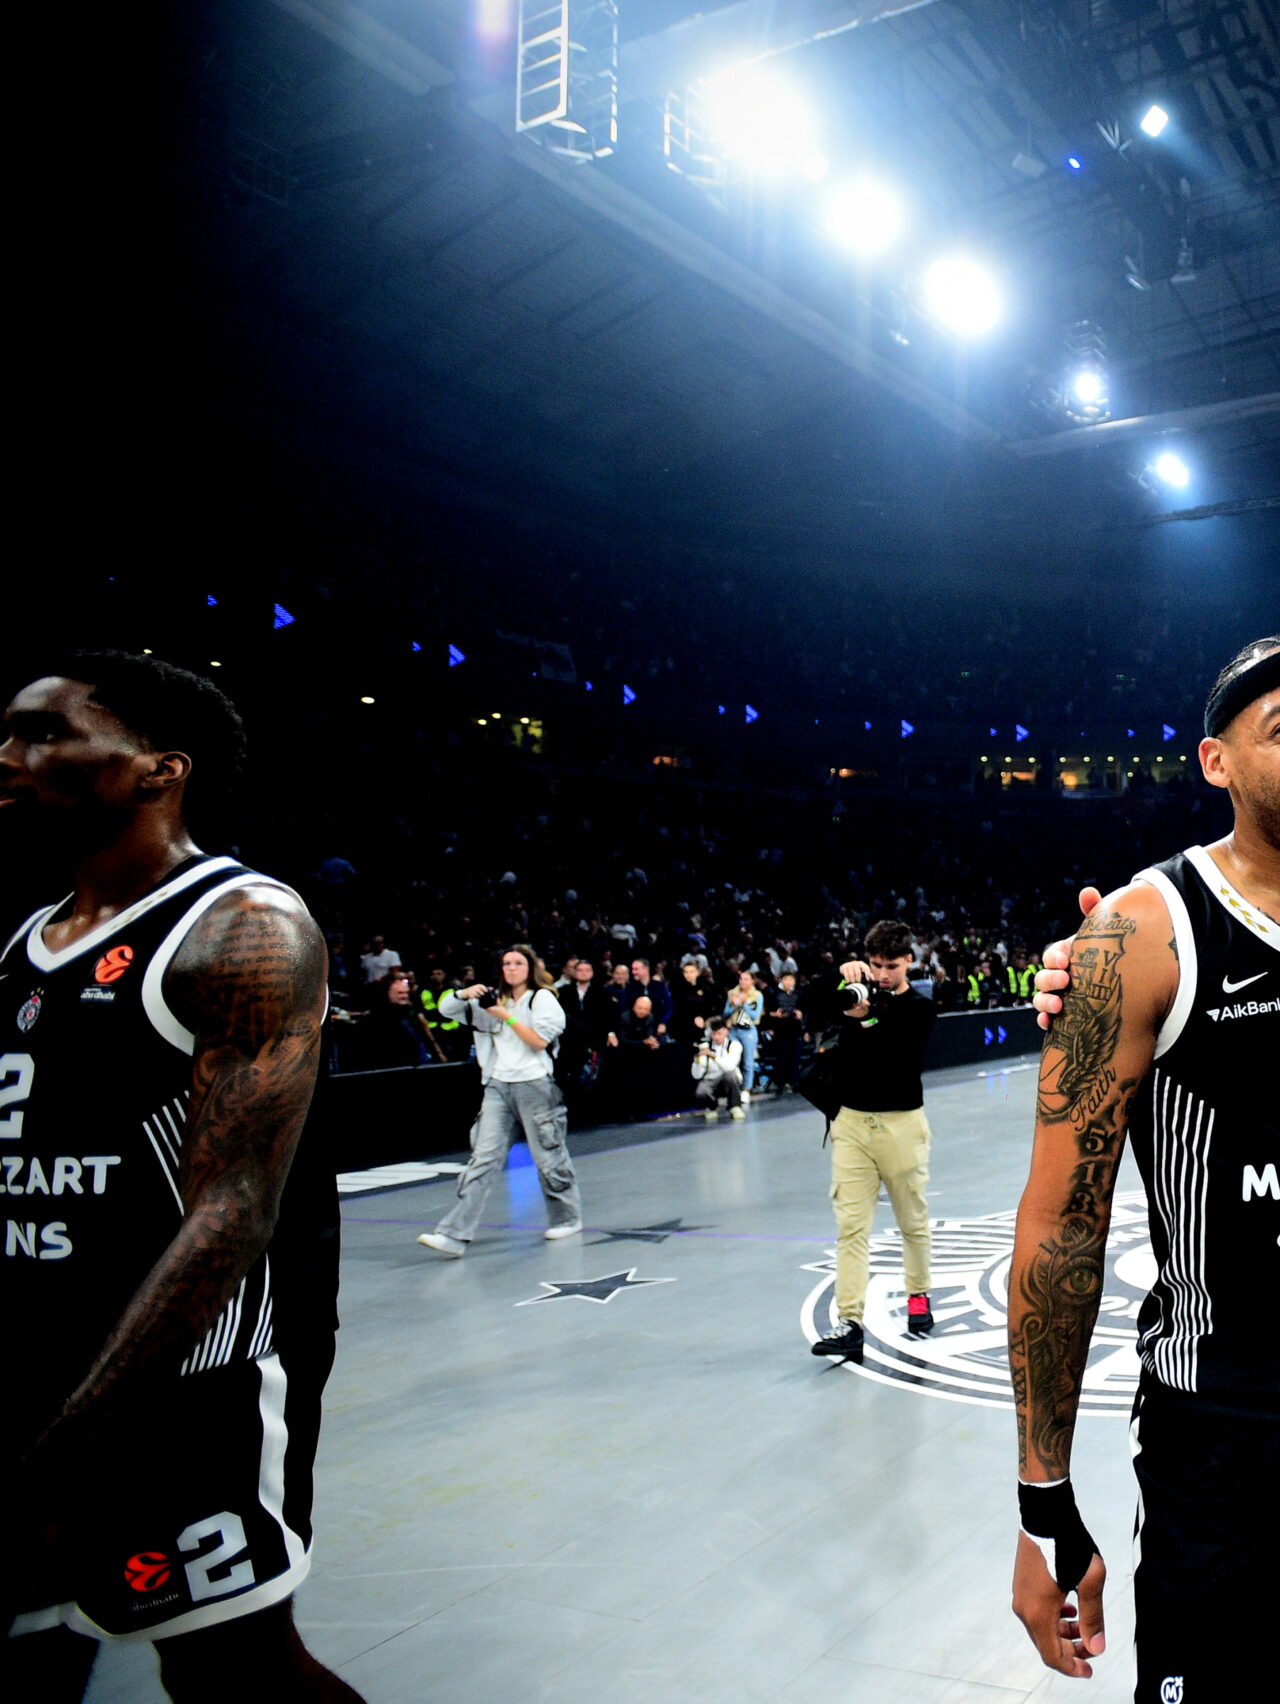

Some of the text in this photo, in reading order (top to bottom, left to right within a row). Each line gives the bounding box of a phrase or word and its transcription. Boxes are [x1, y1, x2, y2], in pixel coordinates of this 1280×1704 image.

[0, 1053, 35, 1139] 2
[0, 1156, 122, 1195] ZART
[176, 1511, 255, 1602] 2
